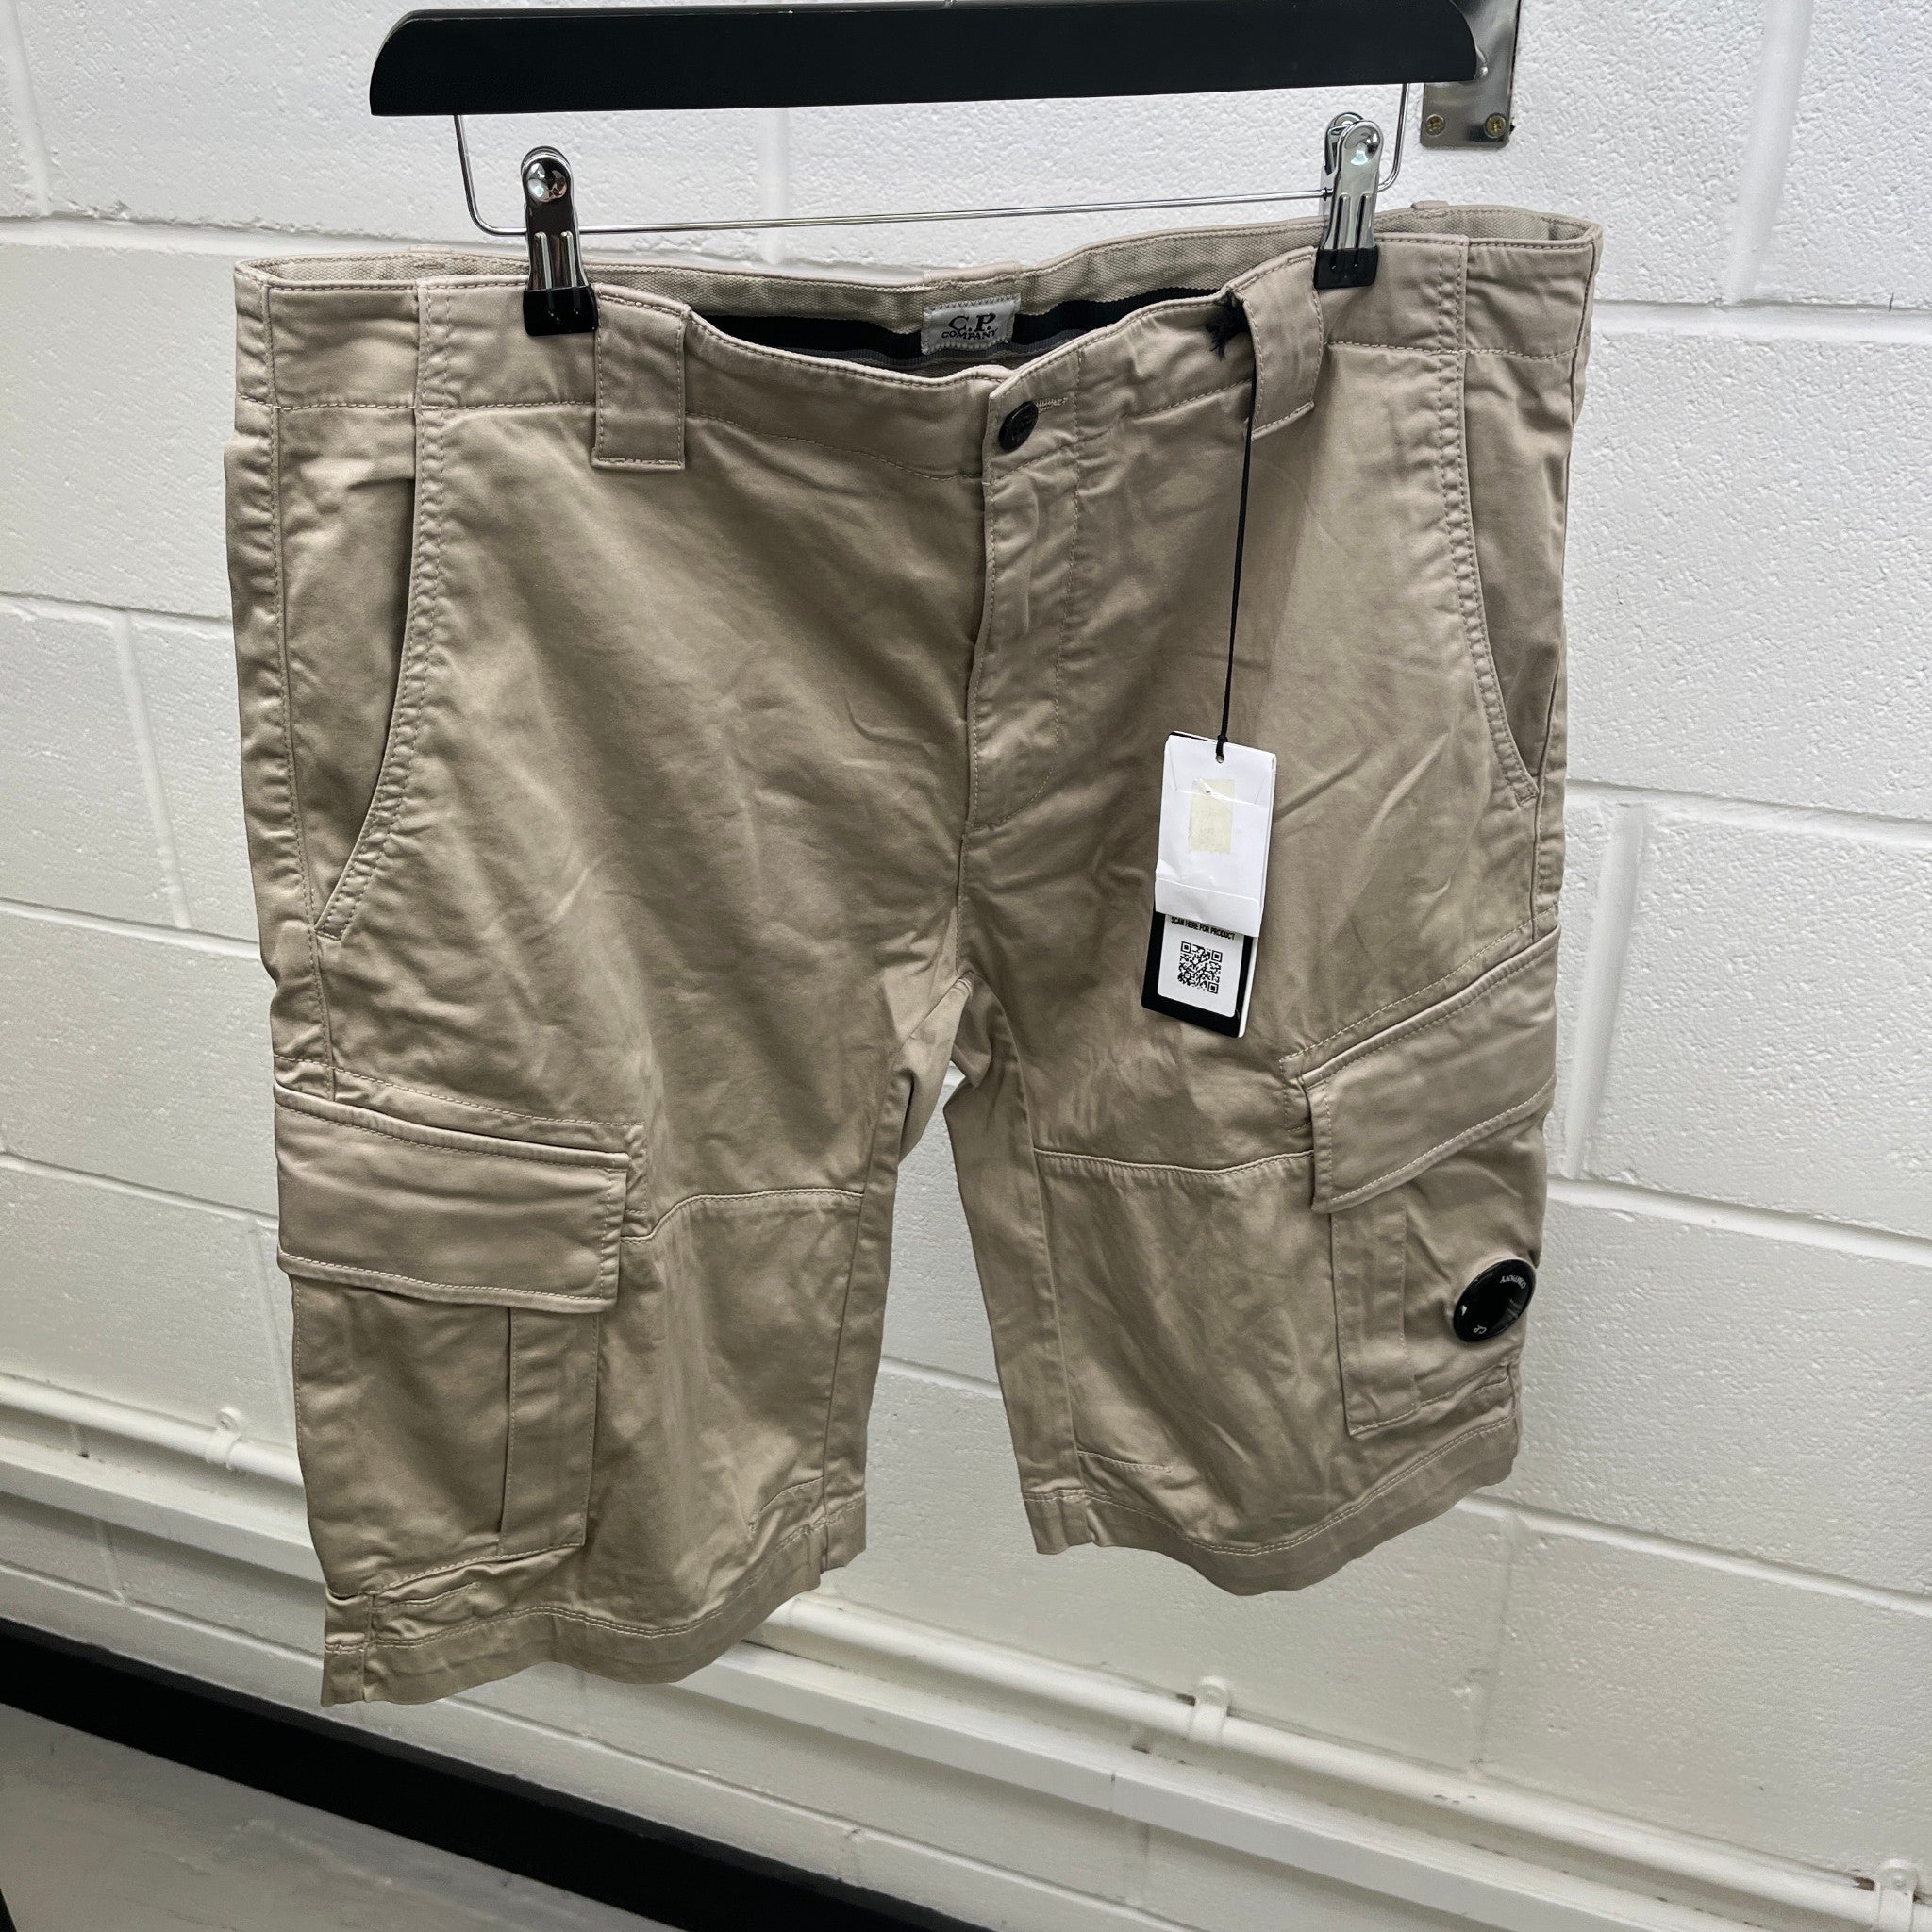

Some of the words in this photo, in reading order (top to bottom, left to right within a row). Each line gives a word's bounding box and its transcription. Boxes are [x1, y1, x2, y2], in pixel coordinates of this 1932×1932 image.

[948, 312, 996, 332] C.P.
[941, 327, 999, 340] COMPANY
[1170, 916, 1185, 926] SCAN
[1185, 919, 1199, 930] HERE
[1199, 924, 1210, 934] FOR
[1210, 927, 1236, 941] PRODUCT
